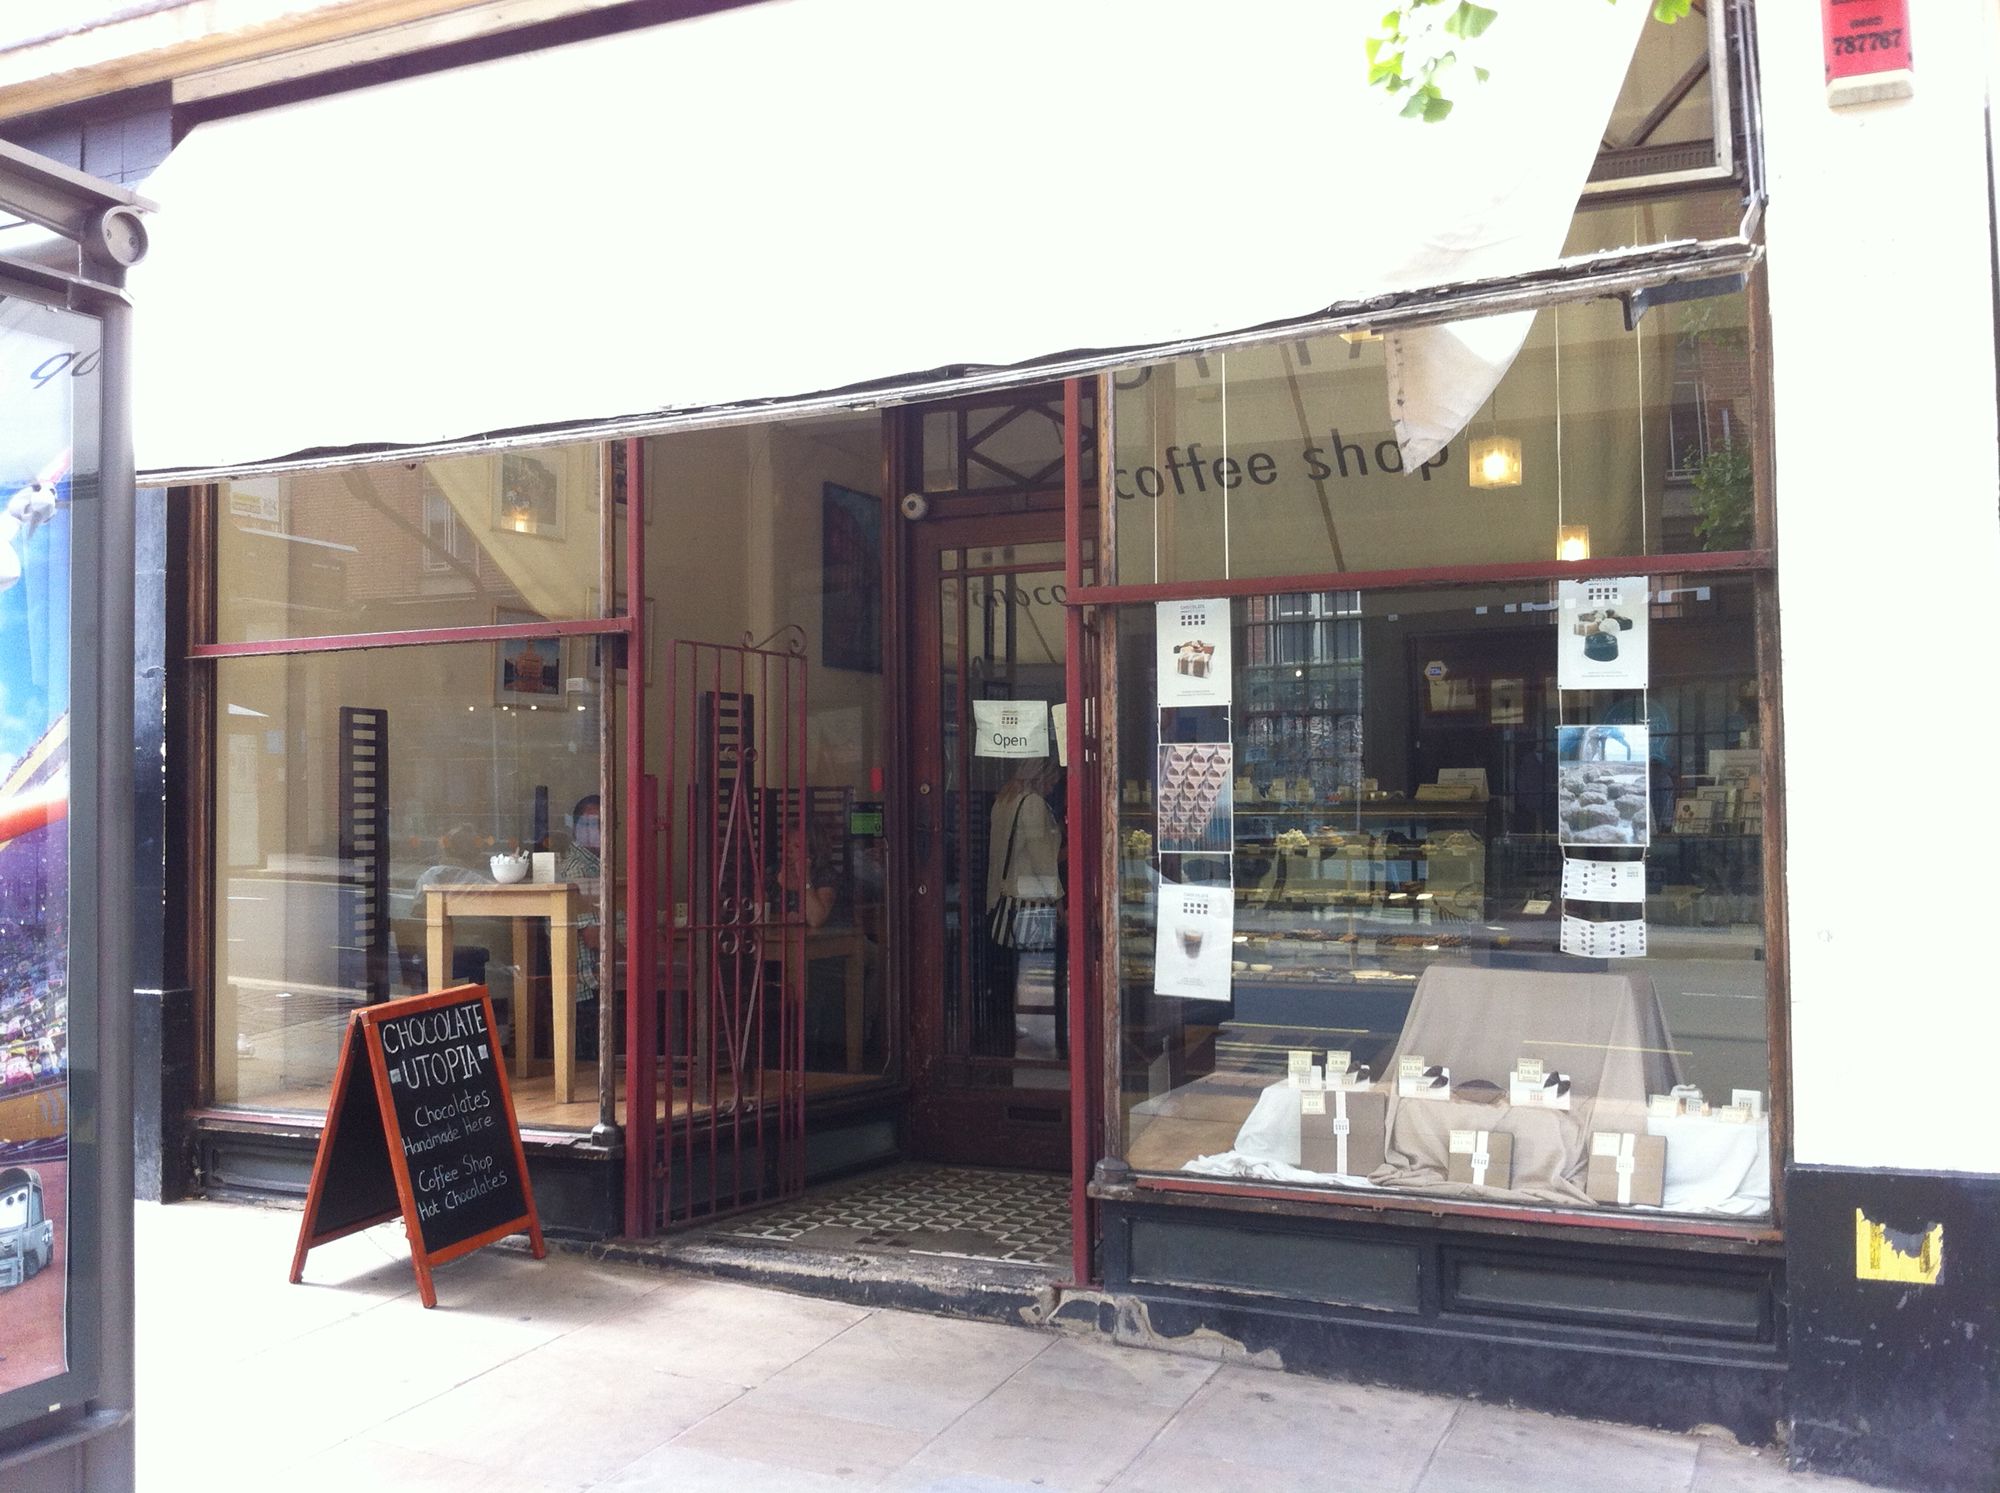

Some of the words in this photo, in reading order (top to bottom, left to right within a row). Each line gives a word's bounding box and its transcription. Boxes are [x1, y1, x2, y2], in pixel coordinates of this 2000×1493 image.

[1114, 442, 1278, 500] coffee
[1302, 427, 1449, 482] shop
[993, 733, 1027, 749] Open
[382, 1003, 488, 1054] CHOCOLATE
[402, 1044, 483, 1089] UTOPIA
[415, 1089, 491, 1127] Chocolates
[402, 1126, 461, 1156] Handmade
[463, 1113, 495, 1134] Here
[418, 1168, 460, 1193] Coffee
[462, 1153, 494, 1175] Shop
[417, 1200, 441, 1222] Hot
[444, 1170, 508, 1209] Chocolates
